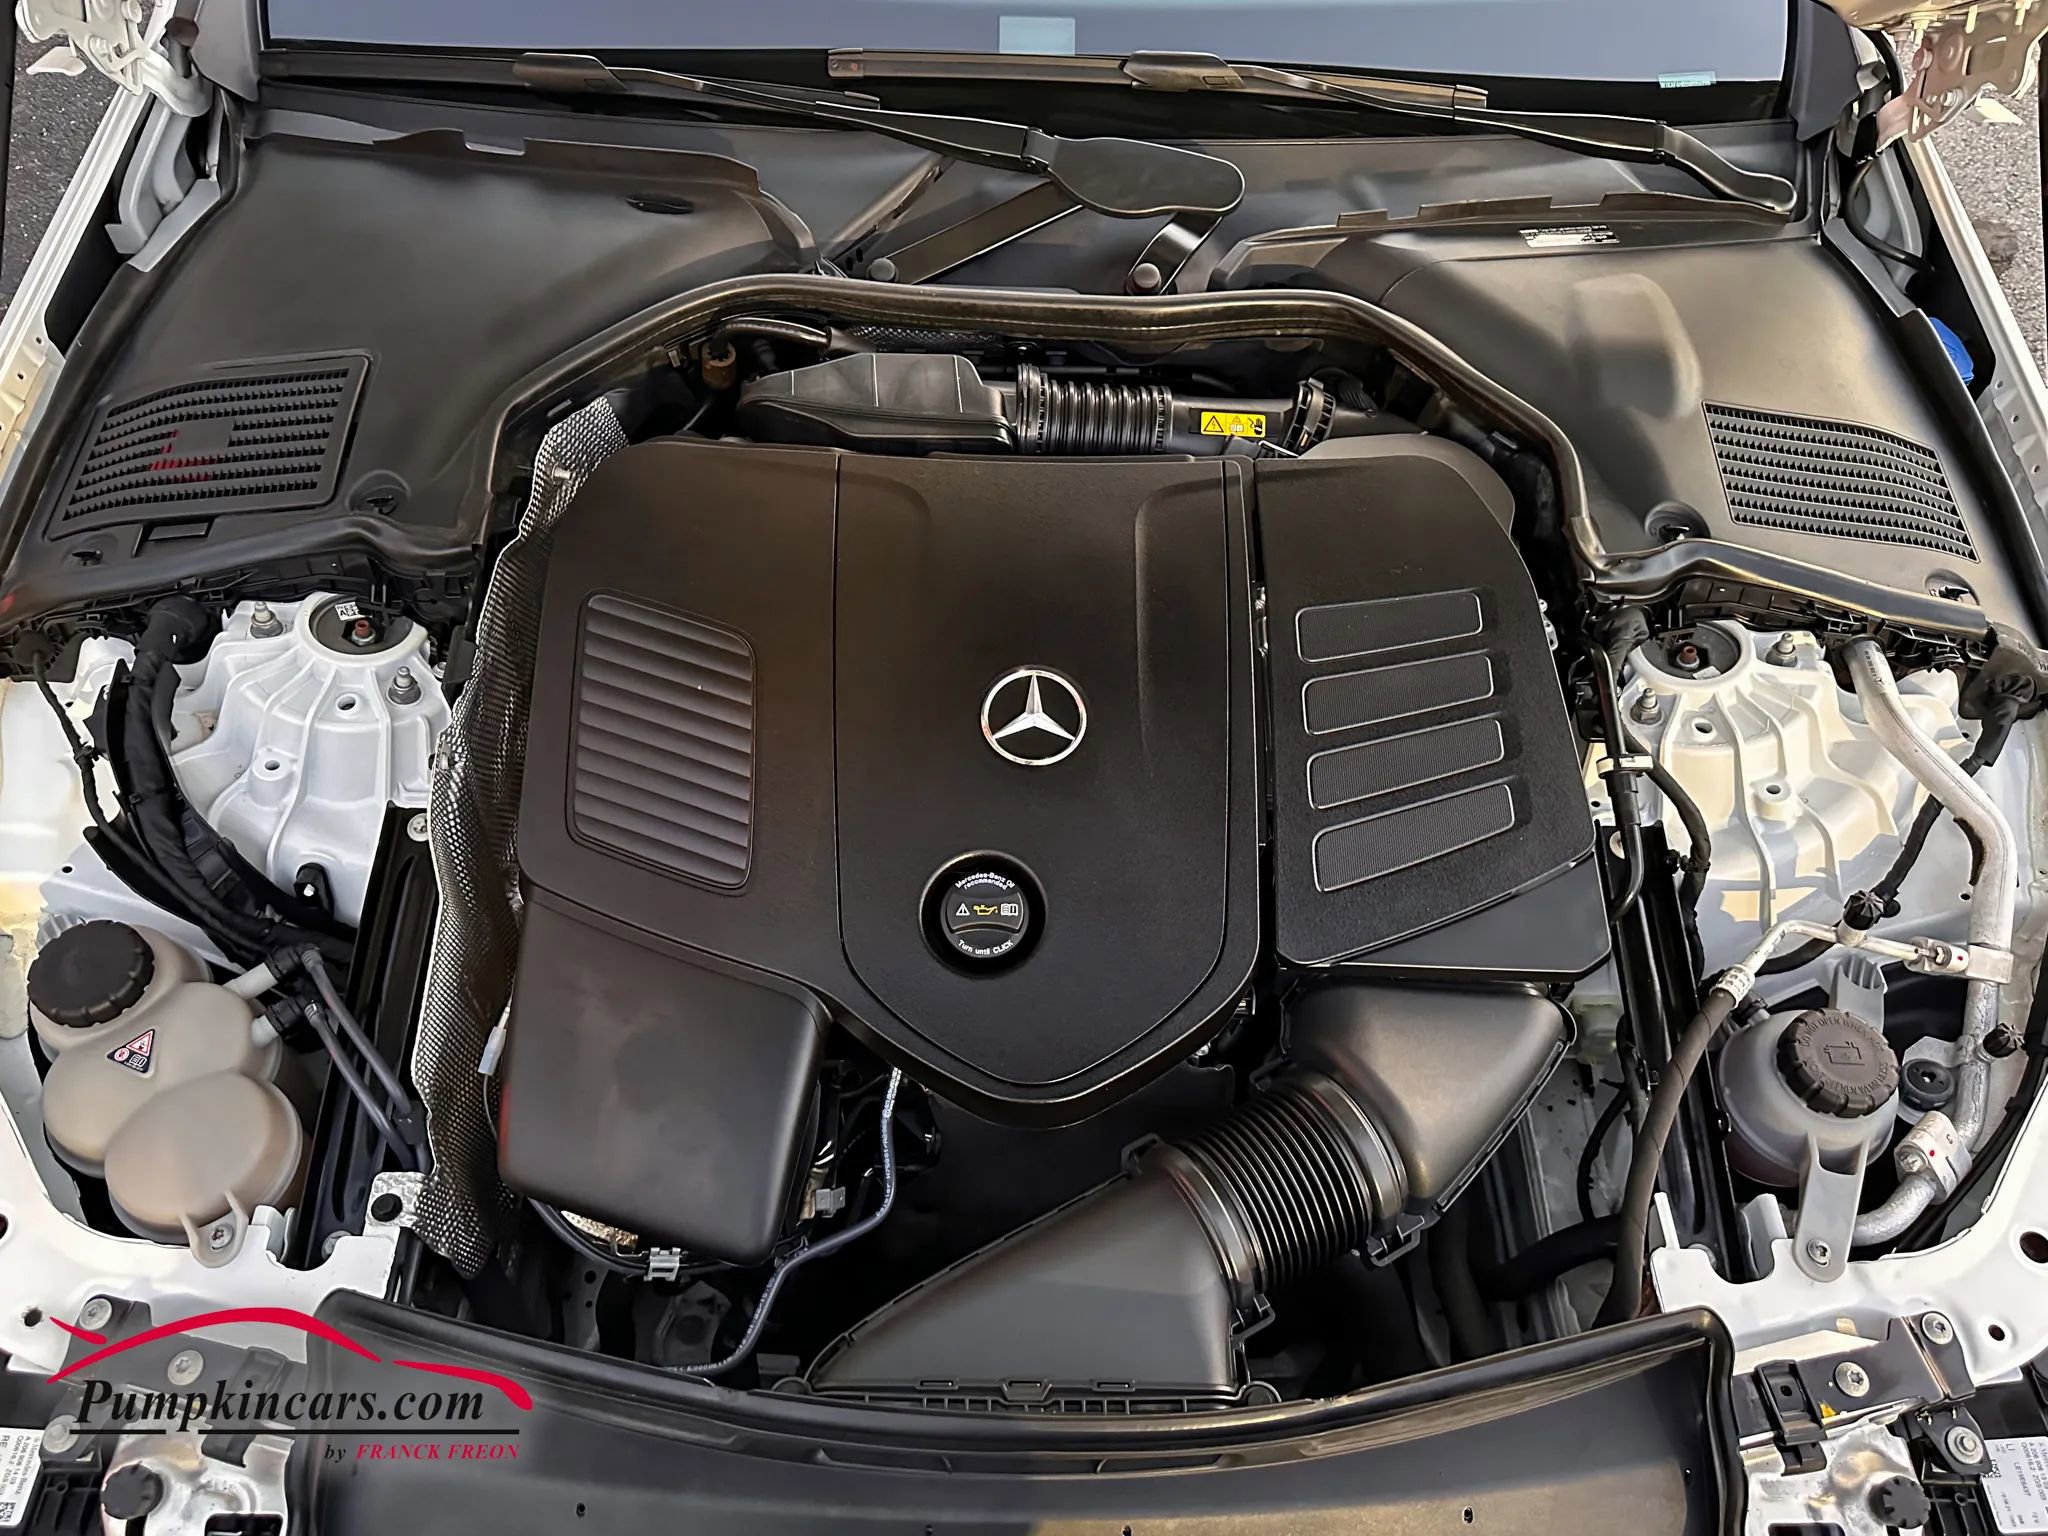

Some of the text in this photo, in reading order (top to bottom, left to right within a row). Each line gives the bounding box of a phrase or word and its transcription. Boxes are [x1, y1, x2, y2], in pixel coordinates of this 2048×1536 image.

[955, 872, 1006, 888] Mercedes-Benz
[964, 878, 1008, 890] recommended
[958, 939, 1014, 955] Turn until CLICK
